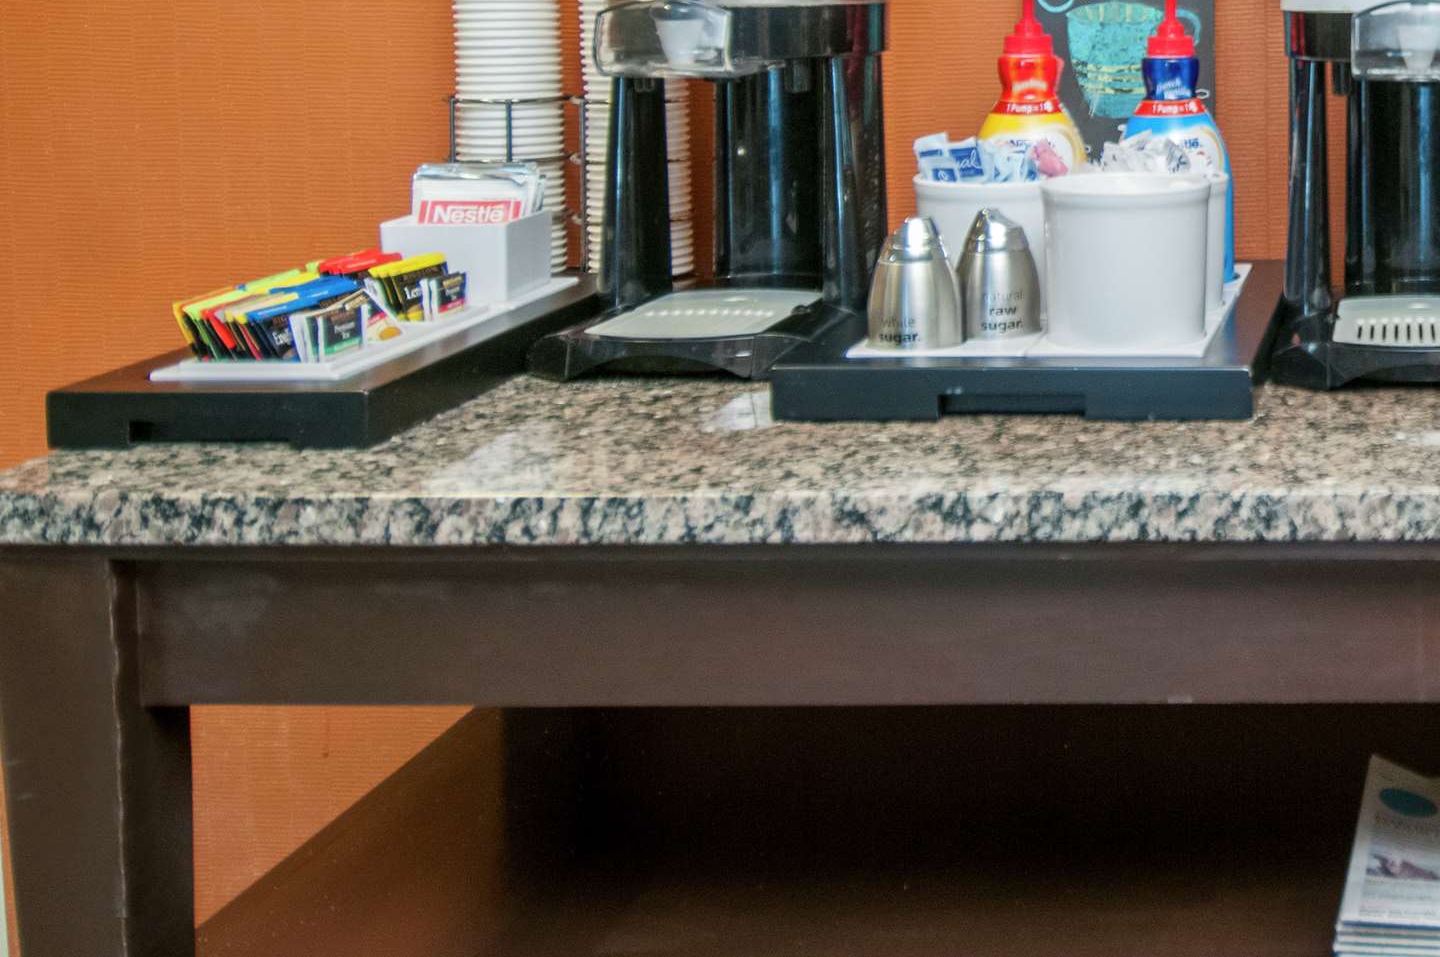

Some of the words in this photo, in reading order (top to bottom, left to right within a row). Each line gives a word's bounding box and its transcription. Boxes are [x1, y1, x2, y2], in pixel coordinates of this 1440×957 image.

[984, 290, 1024, 302] natural
[989, 306, 1017, 317] raw
[981, 319, 1025, 333] sugar.
[879, 332, 921, 346] sugar.
